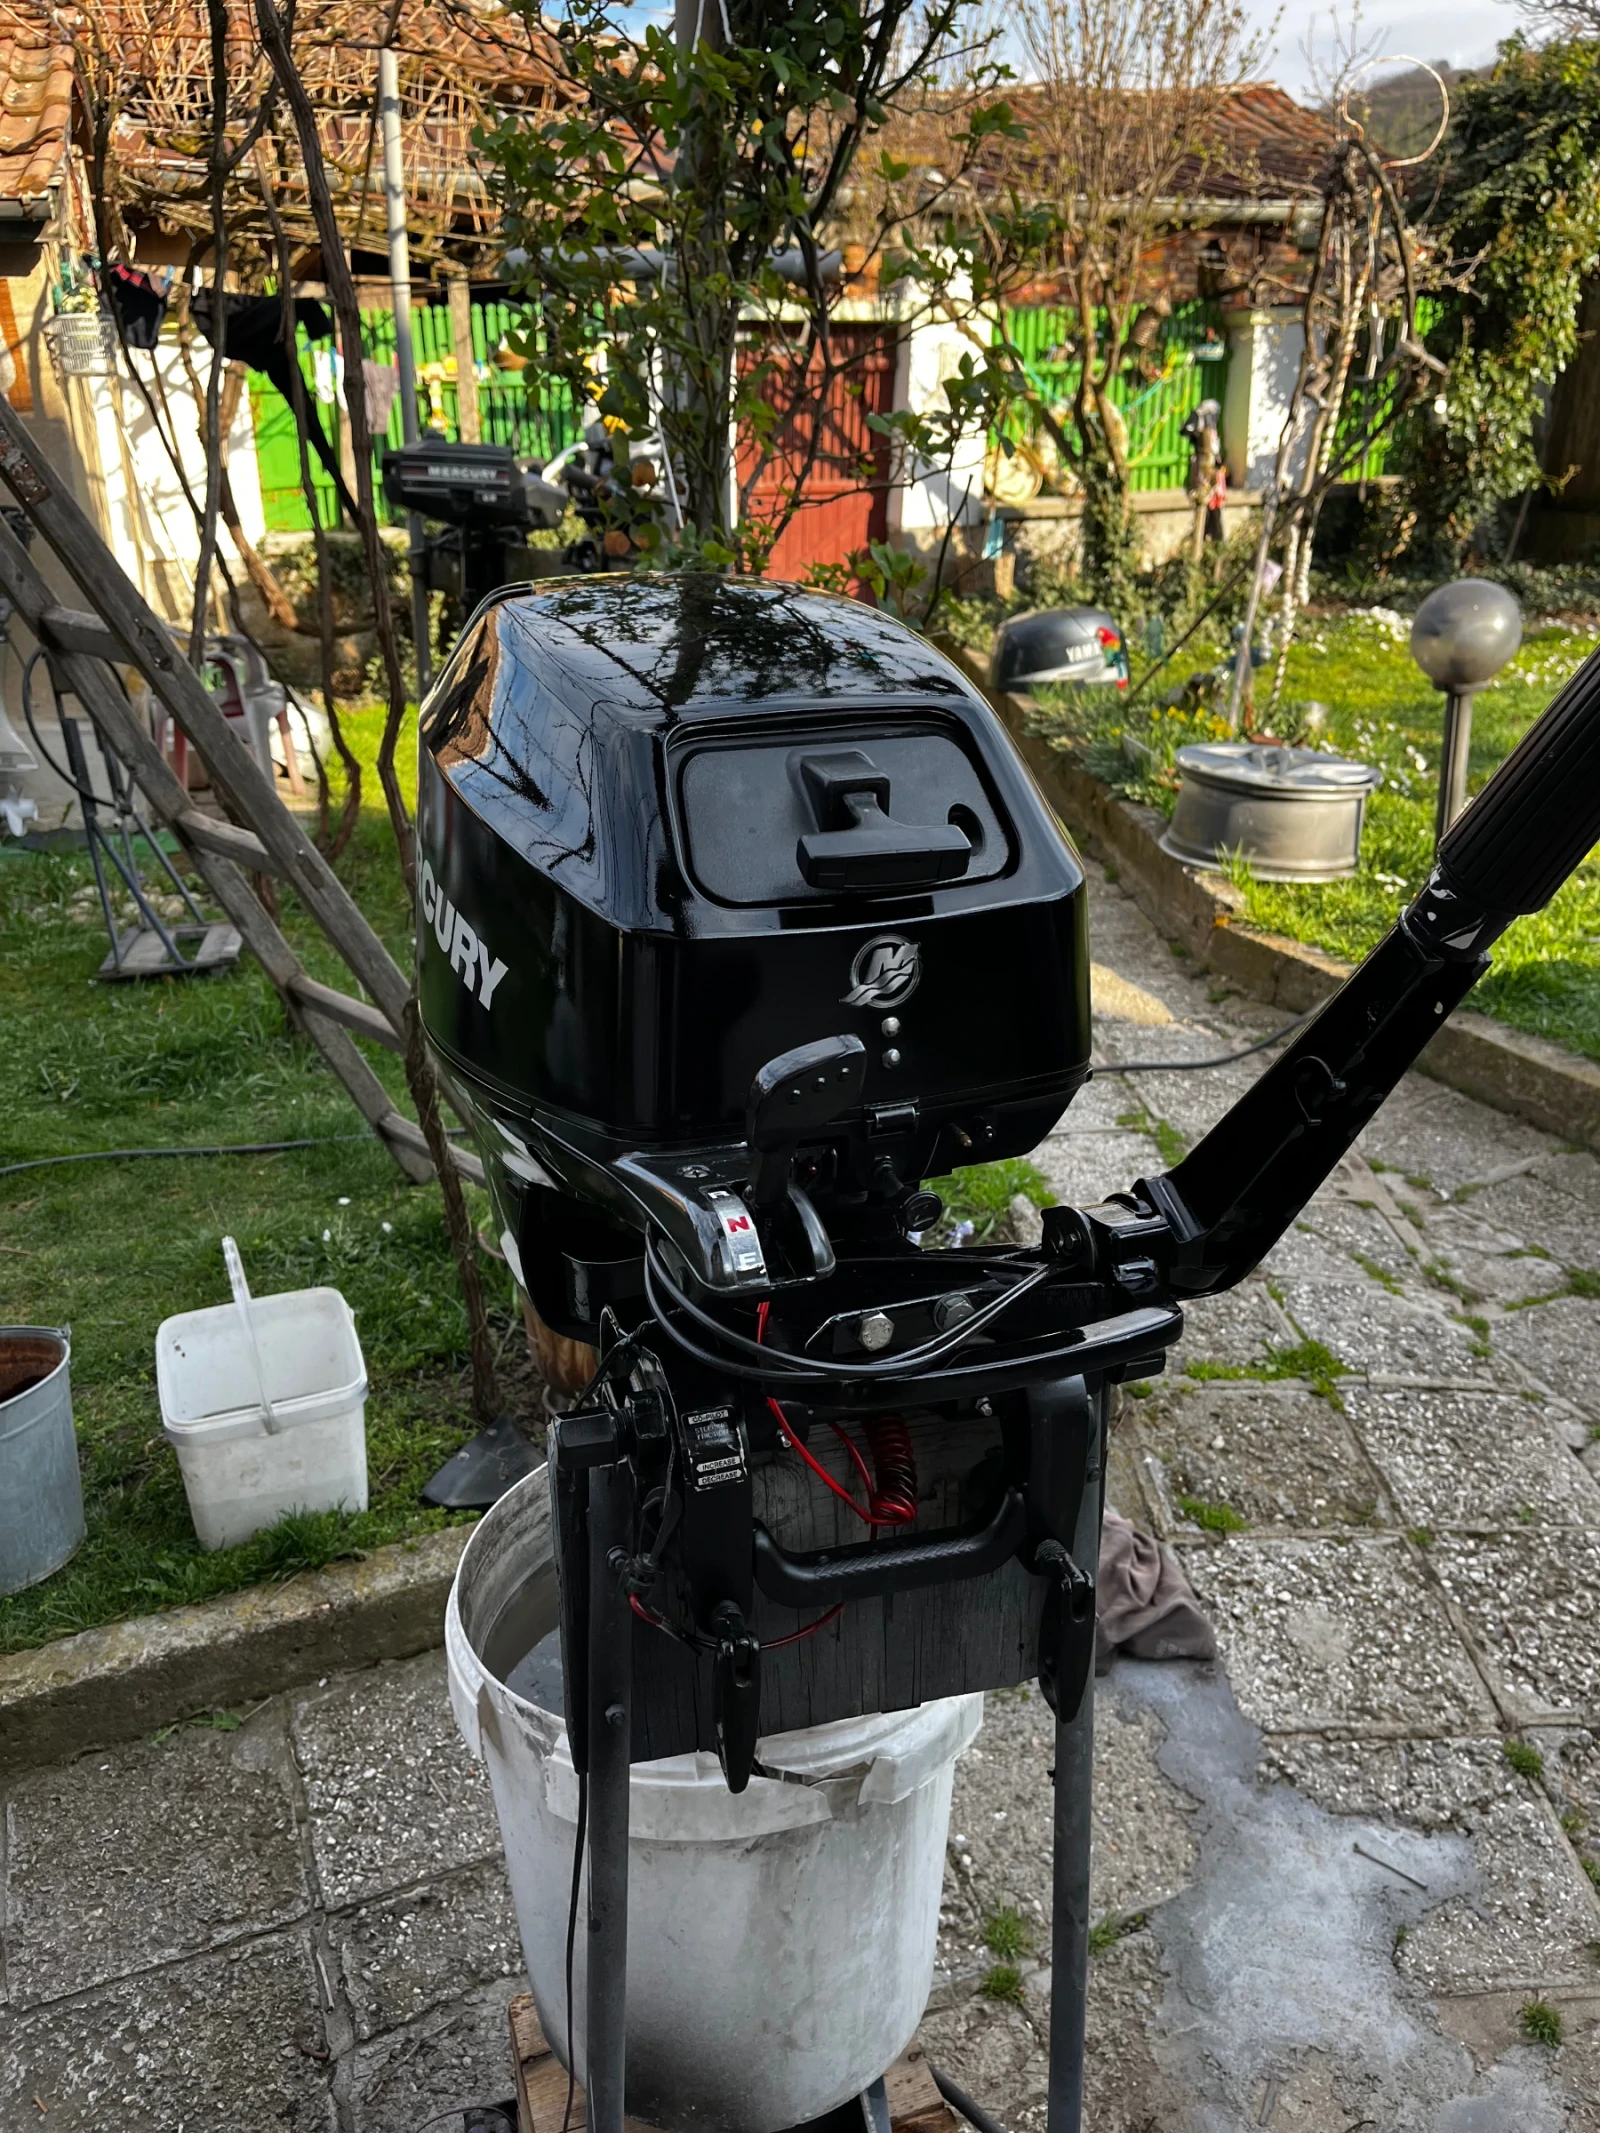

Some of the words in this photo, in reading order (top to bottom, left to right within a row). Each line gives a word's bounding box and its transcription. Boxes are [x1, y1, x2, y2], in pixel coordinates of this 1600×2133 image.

[427, 465, 498, 480] MERCURY
[726, 1215, 751, 1233] N
[692, 1411, 727, 1423] CO-PILOT
[702, 1458, 738, 1471] INCREASE
[701, 1471, 738, 1484] DECREASE
